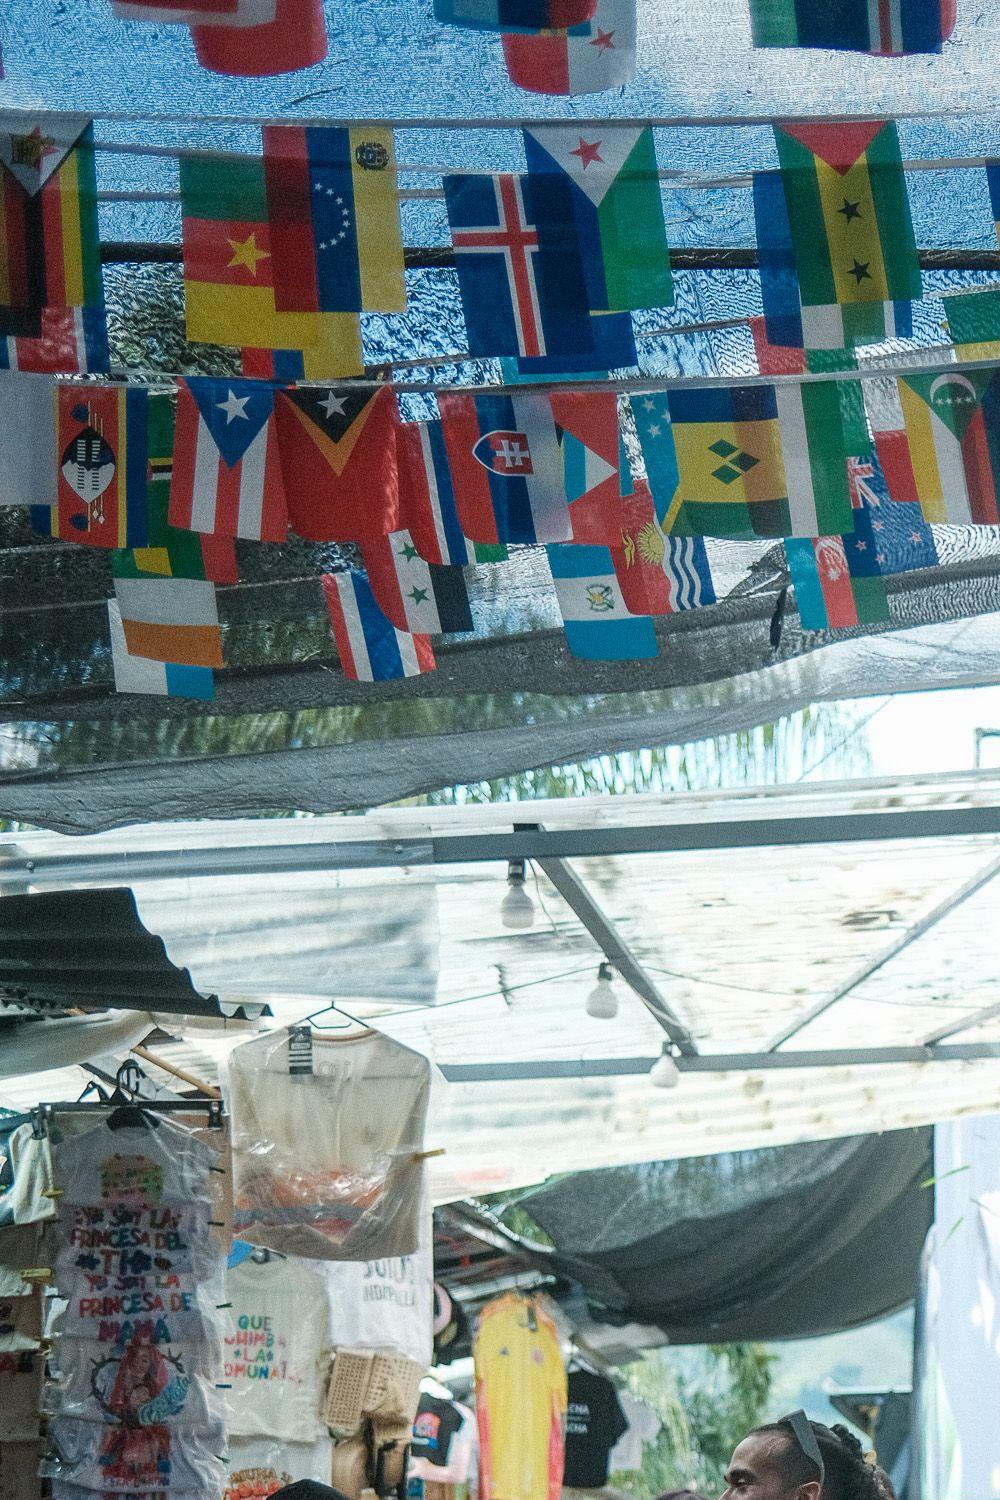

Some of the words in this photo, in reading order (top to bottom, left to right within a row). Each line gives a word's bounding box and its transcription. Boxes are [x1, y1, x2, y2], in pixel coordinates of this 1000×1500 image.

[79, 1292, 165, 1318] PRINCESA
[169, 1293, 193, 1312] DE
[238, 1315, 274, 1331] QUE
[243, 1348, 266, 1363] LA
